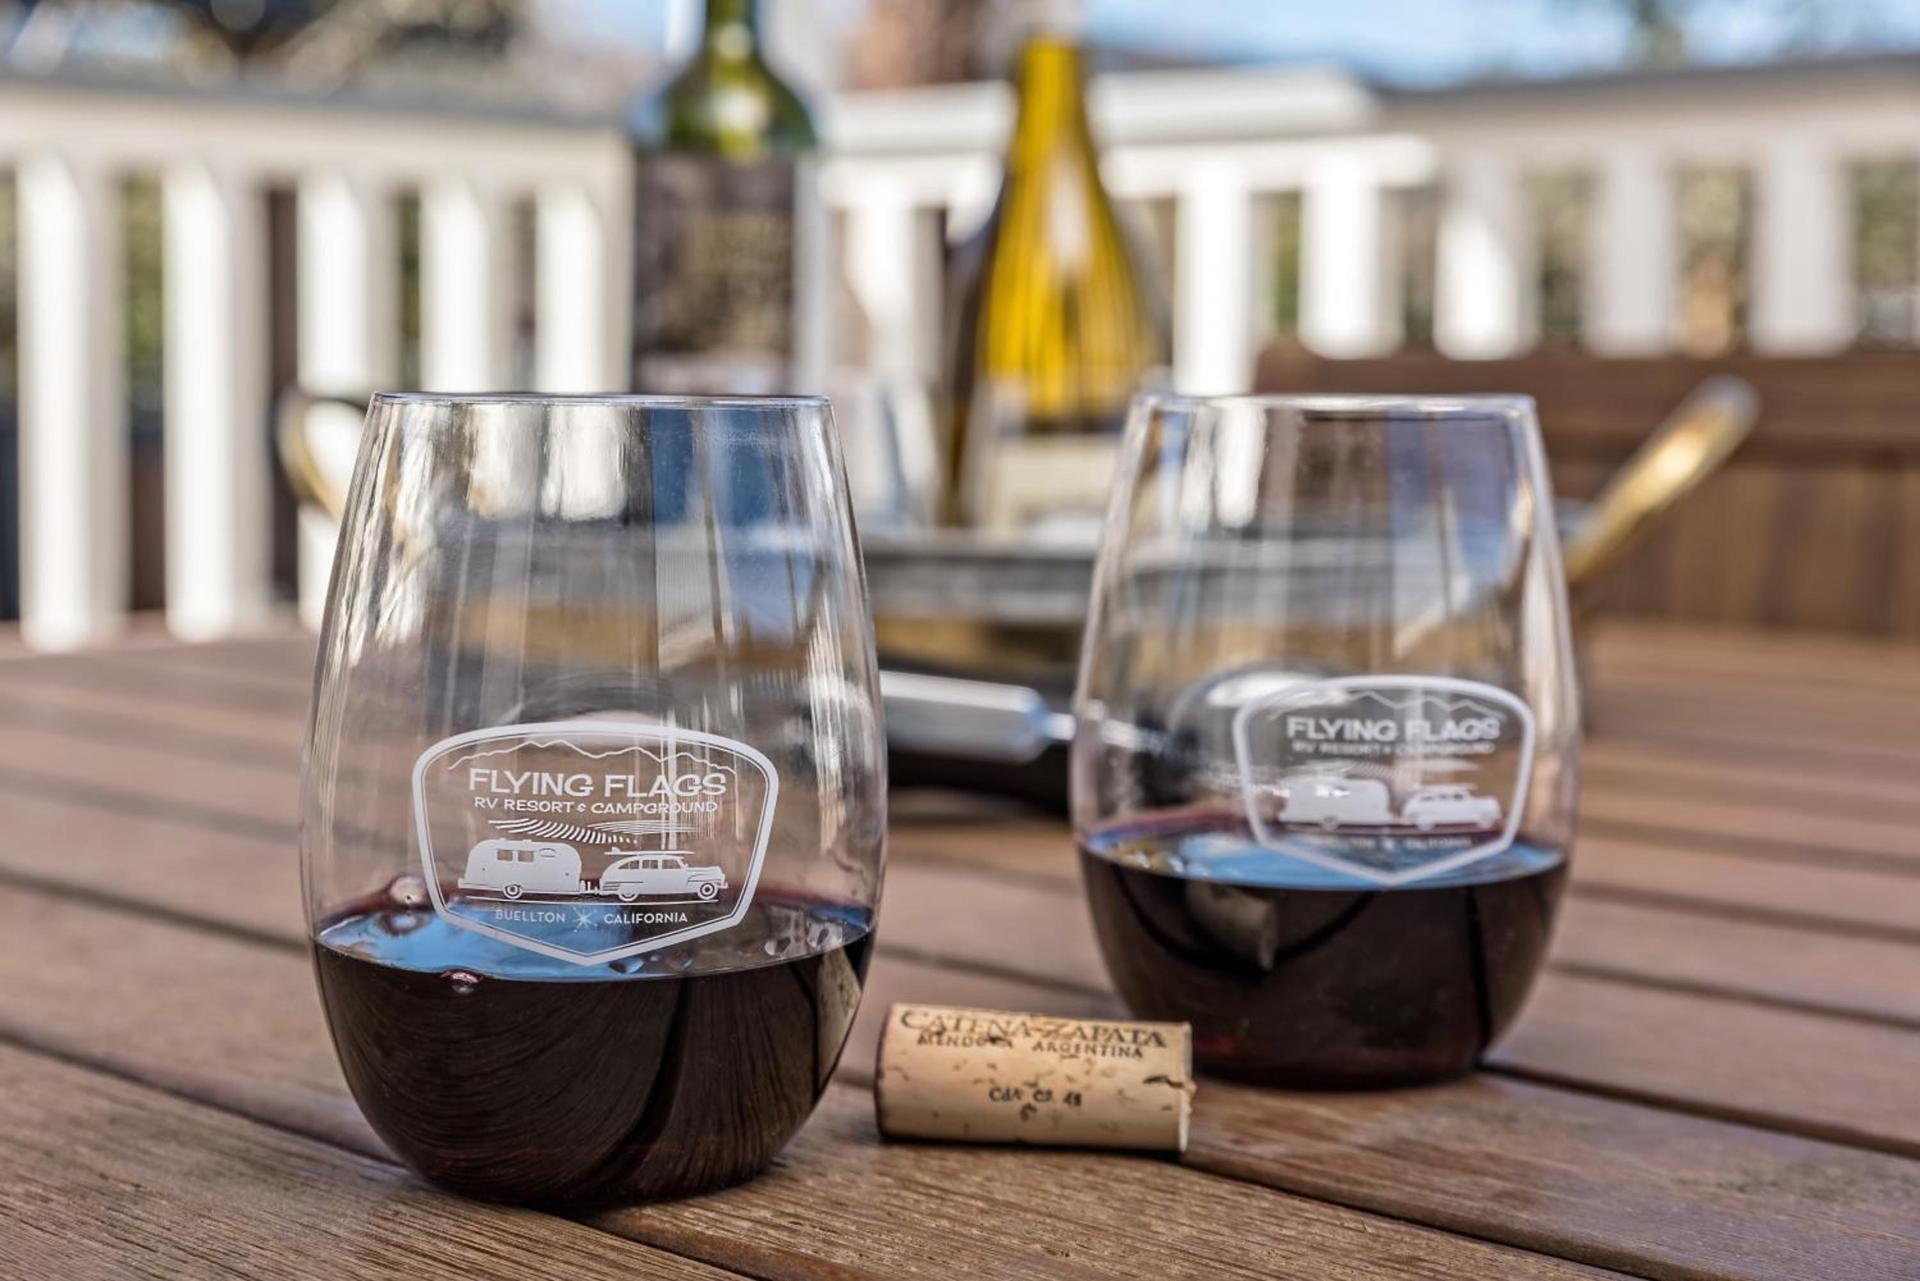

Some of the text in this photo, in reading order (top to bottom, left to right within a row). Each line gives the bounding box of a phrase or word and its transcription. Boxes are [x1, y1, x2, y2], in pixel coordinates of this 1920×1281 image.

[1286, 716, 1501, 742] FLYING FLAGS
[468, 767, 727, 798] FLYING FLAGS
[474, 796, 718, 814] RV RESORT & CAMPGROUND
[495, 909, 689, 925] BUELLTON CALIFORNIA
[1032, 1040, 1144, 1059] ARGENTINA
